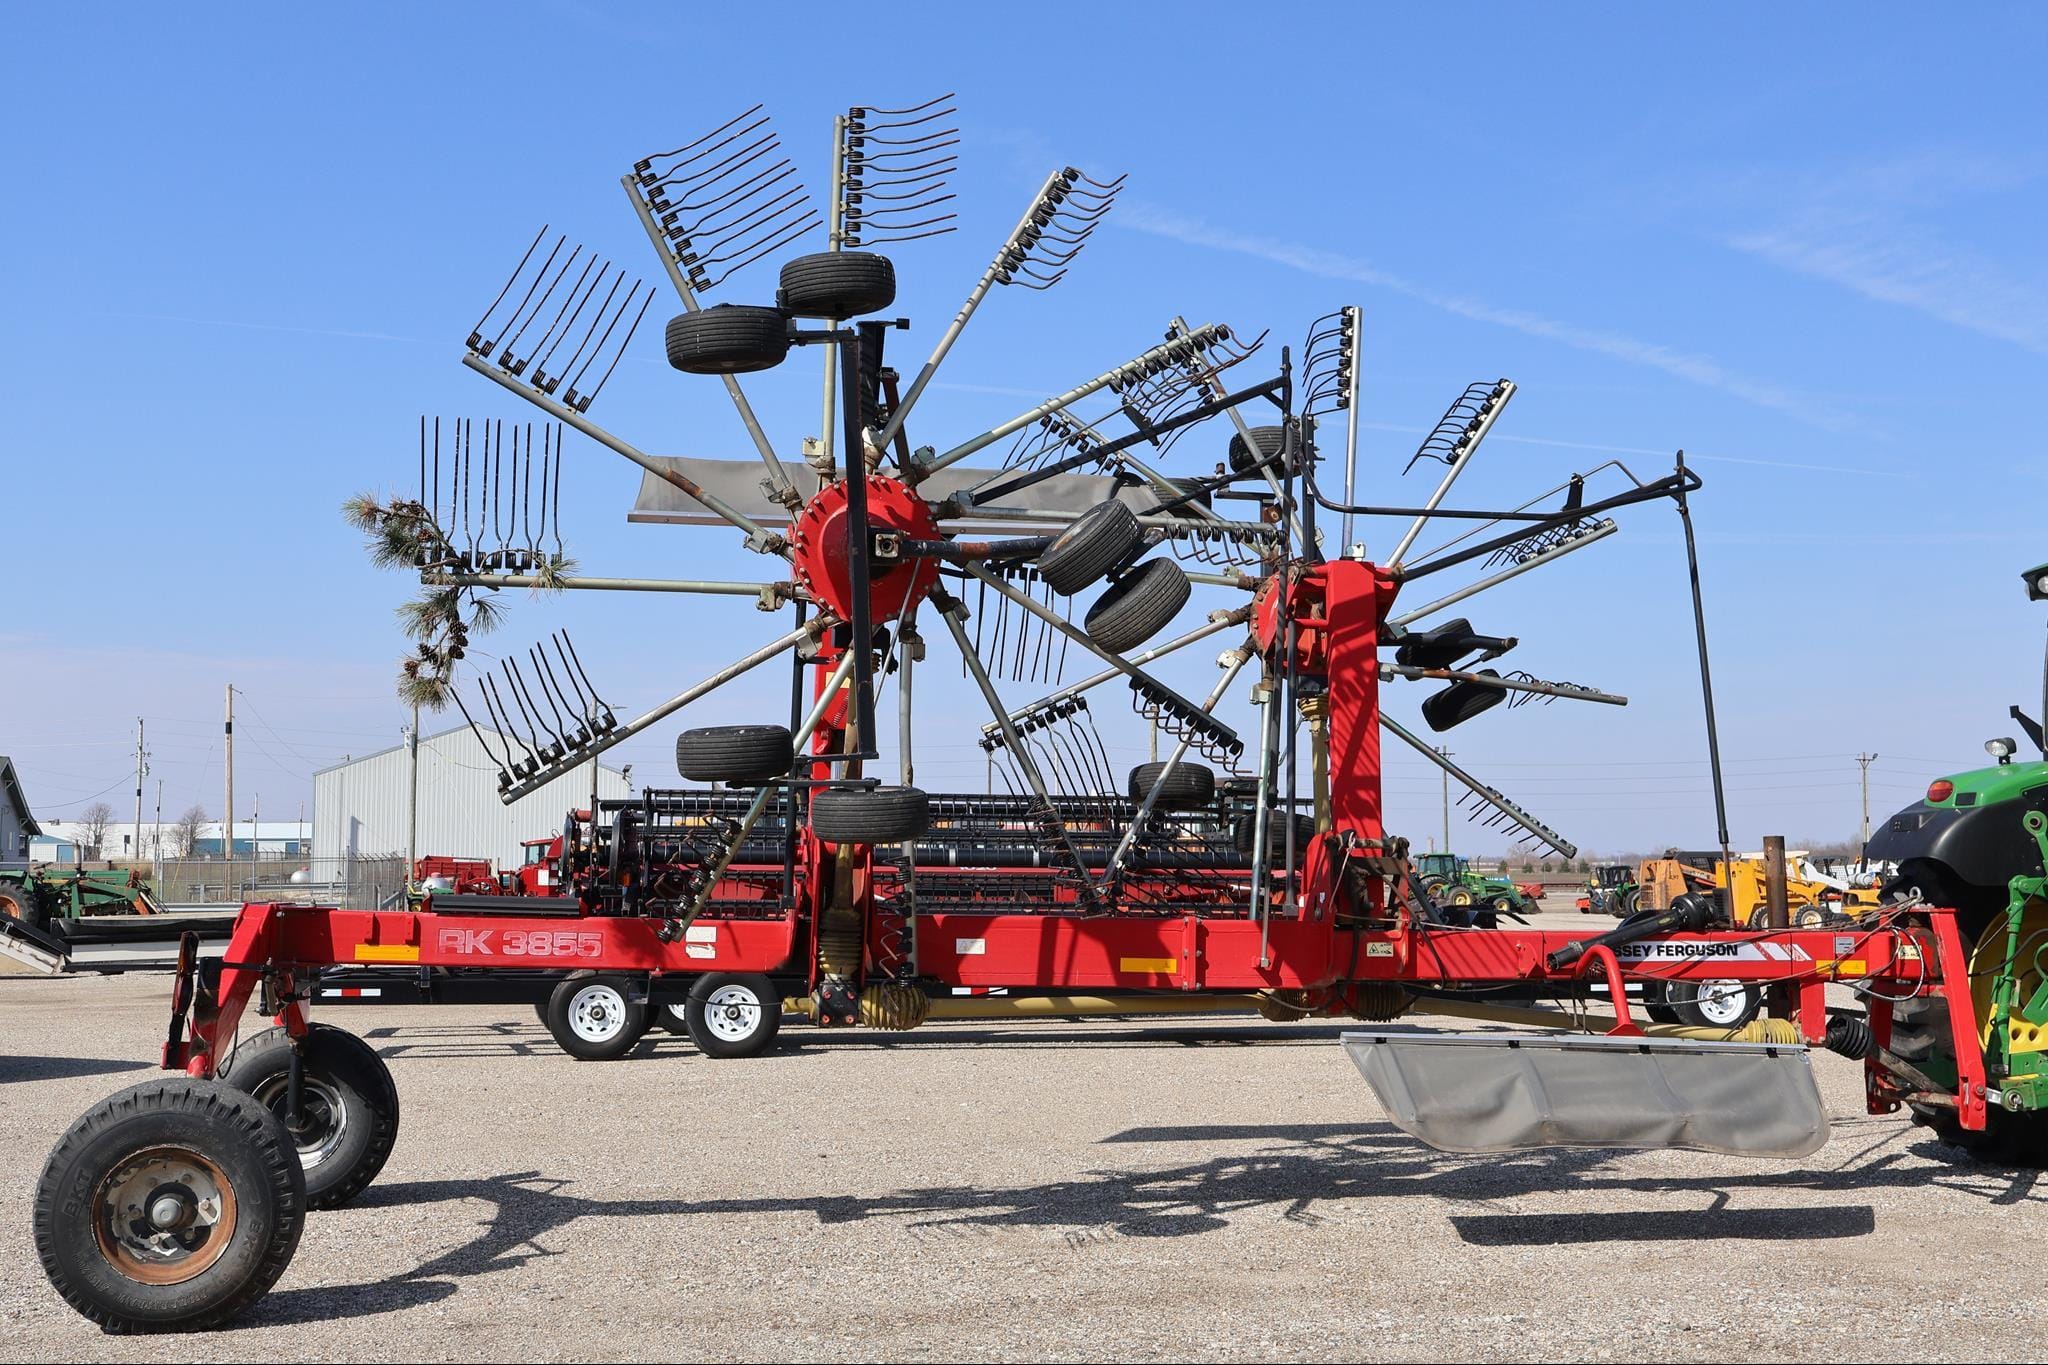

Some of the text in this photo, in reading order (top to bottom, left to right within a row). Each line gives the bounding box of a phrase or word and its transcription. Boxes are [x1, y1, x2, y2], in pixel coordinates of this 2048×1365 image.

[440, 929, 602, 957] RK 3855
[1656, 944, 1738, 957] FERGUSON
[63, 1167, 93, 1218] BKT
